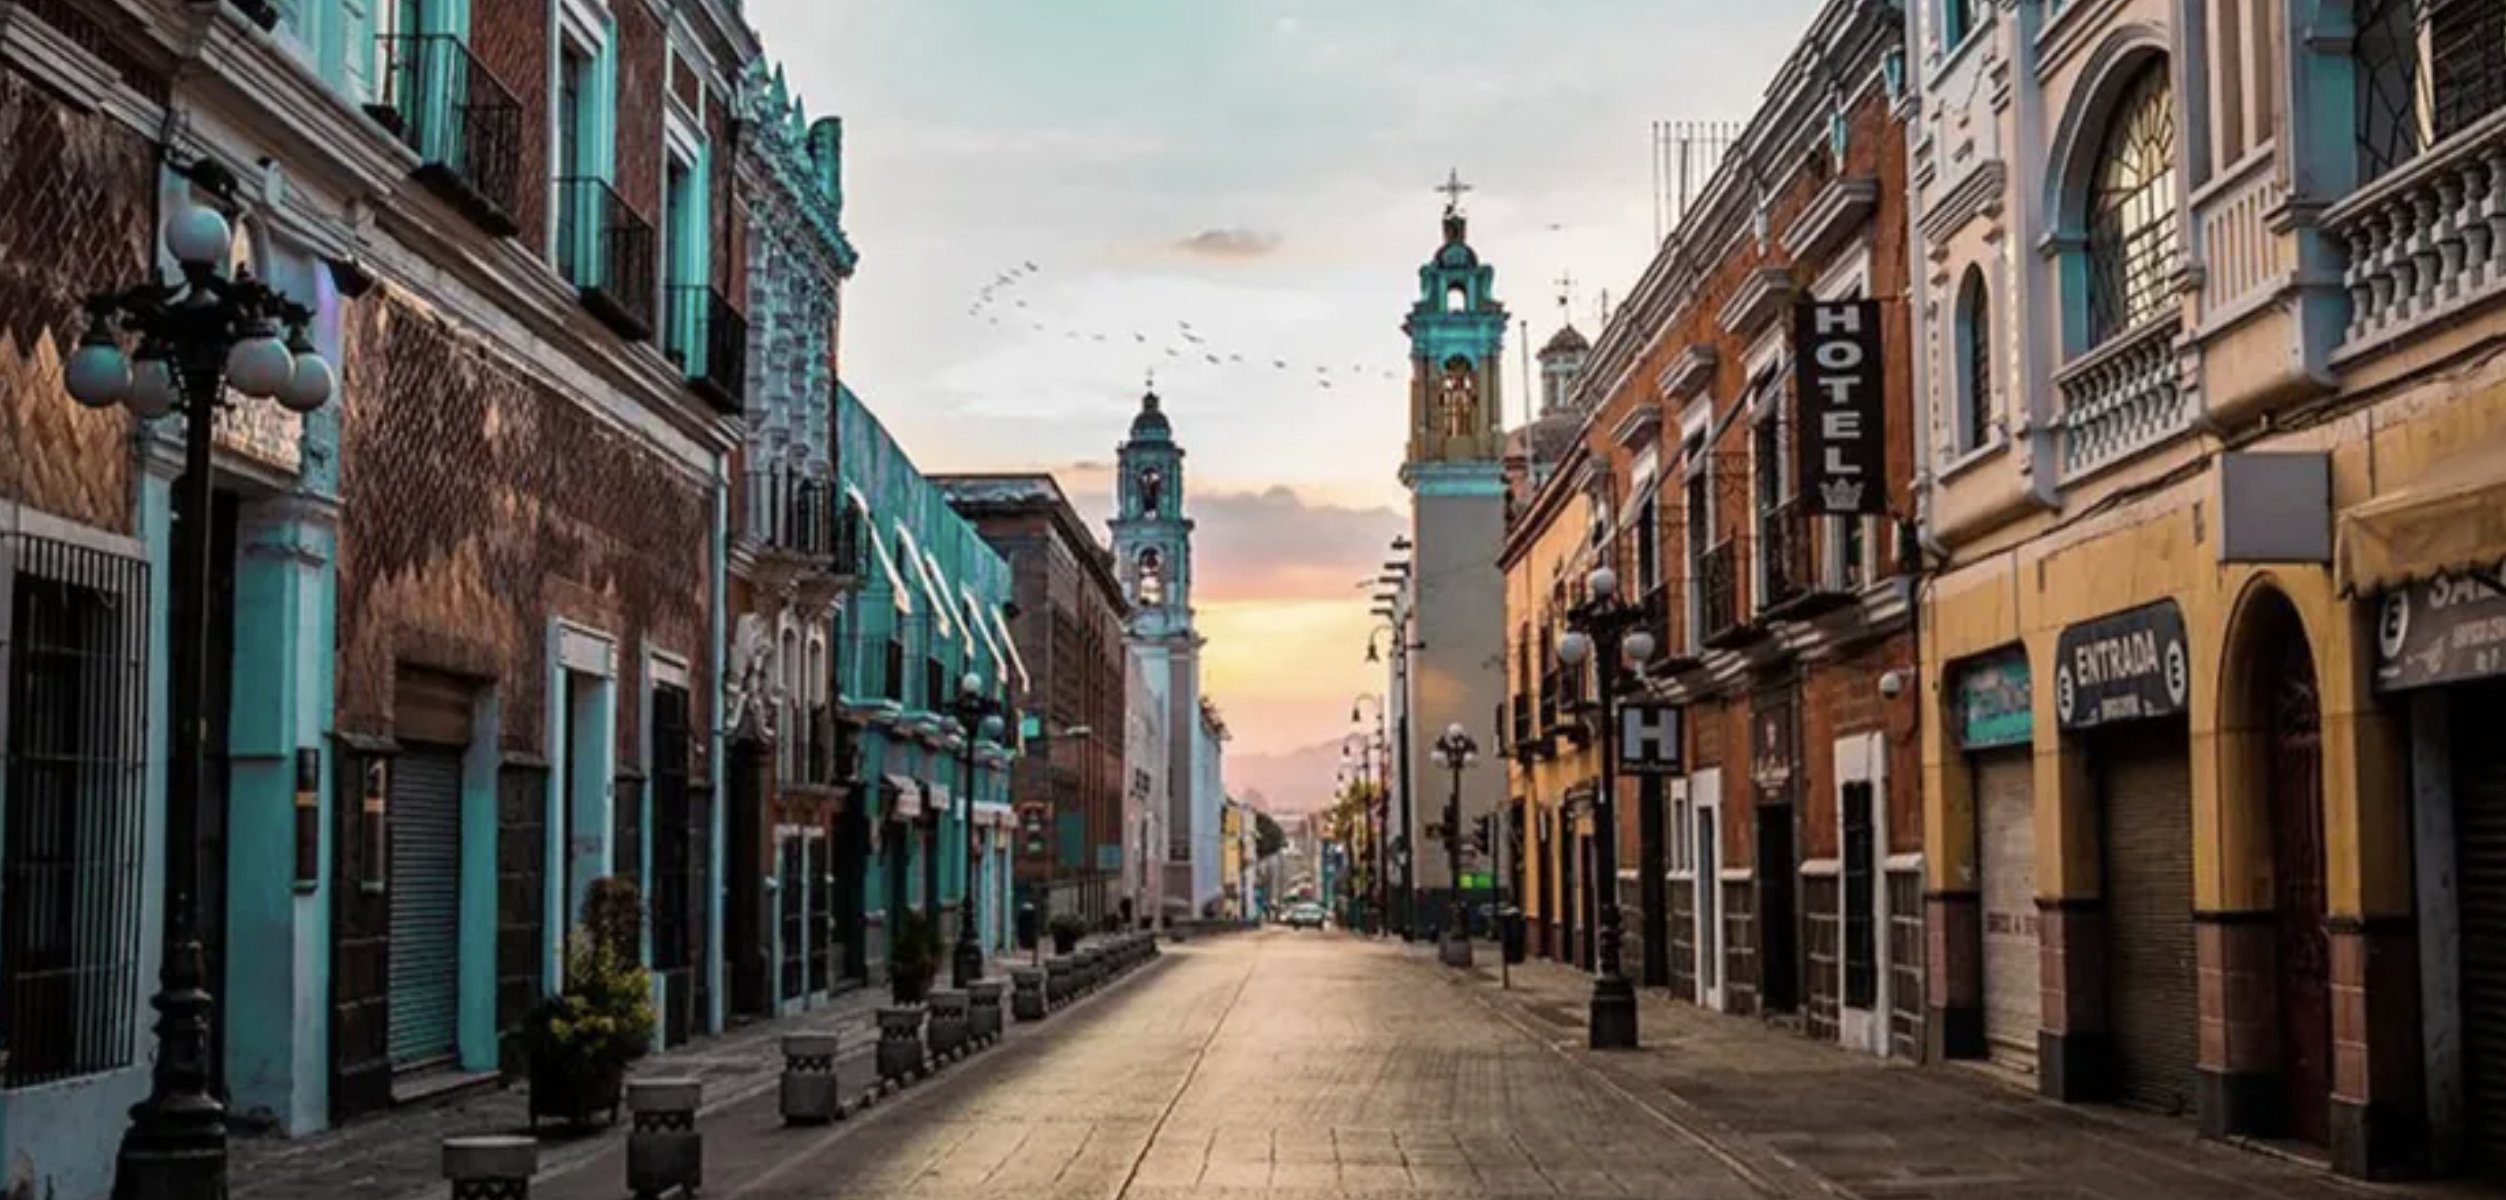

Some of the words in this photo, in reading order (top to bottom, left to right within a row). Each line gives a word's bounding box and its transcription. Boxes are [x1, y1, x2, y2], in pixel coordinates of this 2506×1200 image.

[1814, 304, 1864, 475] HOTEL
[2076, 629, 2160, 687] ENTRADA
[1622, 707, 1678, 760] H
